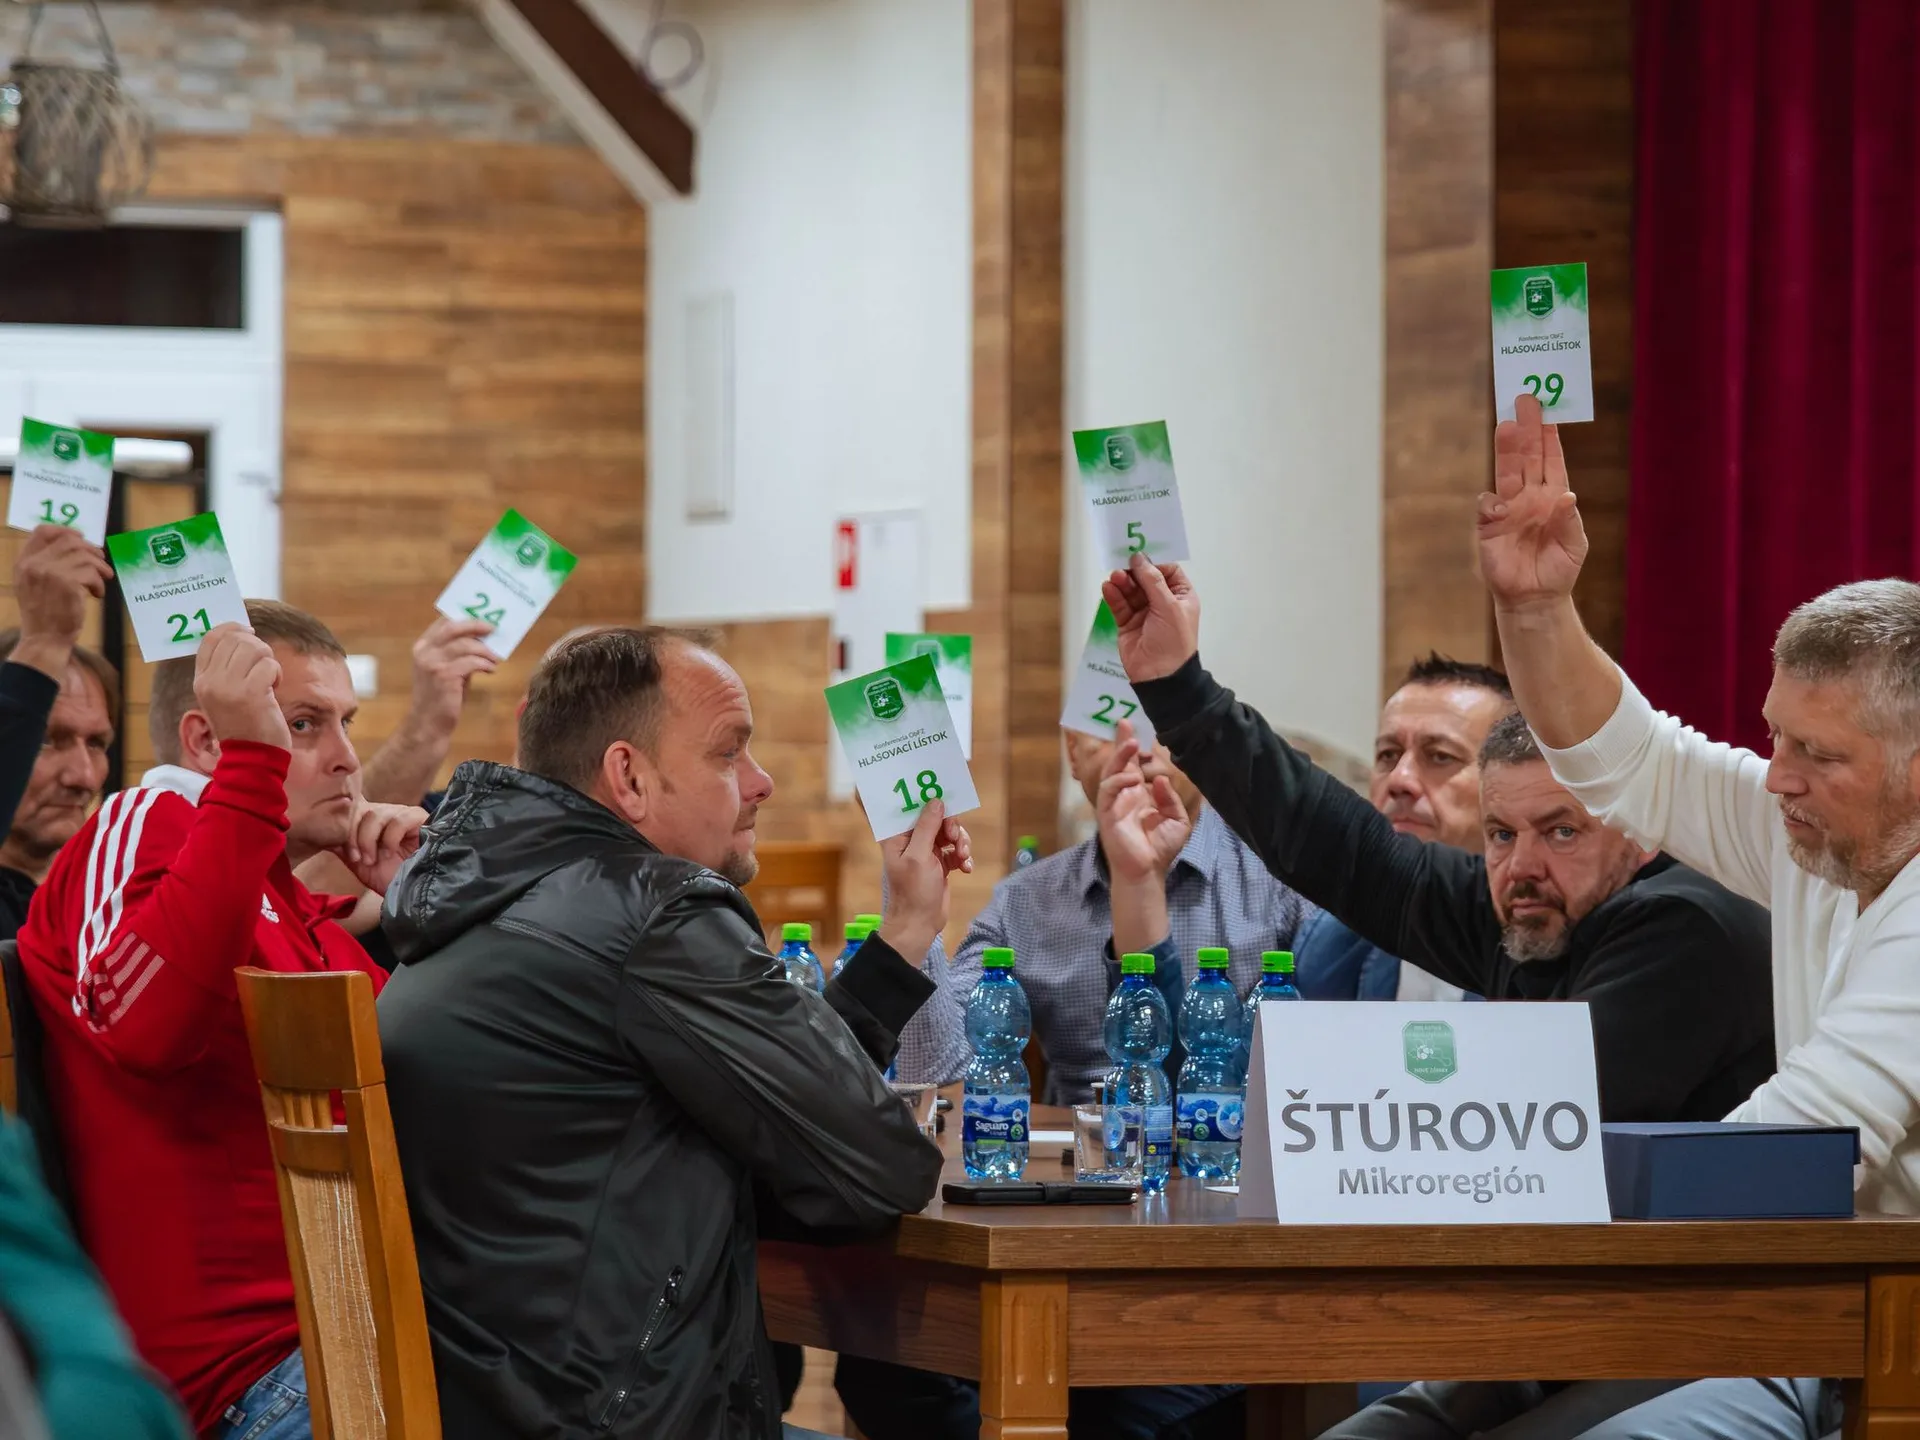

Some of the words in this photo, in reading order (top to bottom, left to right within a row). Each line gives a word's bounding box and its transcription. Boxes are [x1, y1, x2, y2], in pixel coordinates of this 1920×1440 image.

[1501, 342, 1550, 355] HLASOVACÍ
[1552, 340, 1581, 351] LÍSTOK
[1523, 373, 1564, 407] 29
[40, 499, 79, 525] 19
[1127, 521, 1146, 552] 5
[134, 584, 191, 603] HLASOVACÍ
[192, 576, 228, 591] LÍSTOK
[167, 608, 212, 642] 21
[463, 592, 507, 627] 24
[1091, 694, 1138, 724] 27
[858, 741, 913, 768] HLASOVACÍ
[914, 730, 948, 750] LÍSTOK
[873, 735, 908, 751] Konferencia
[892, 769, 944, 813] 18
[975, 1120, 1009, 1132] Saguaro
[1281, 1089, 1588, 1153] ŠTÚROVO
[1338, 1166, 1546, 1203] Mikroregión
